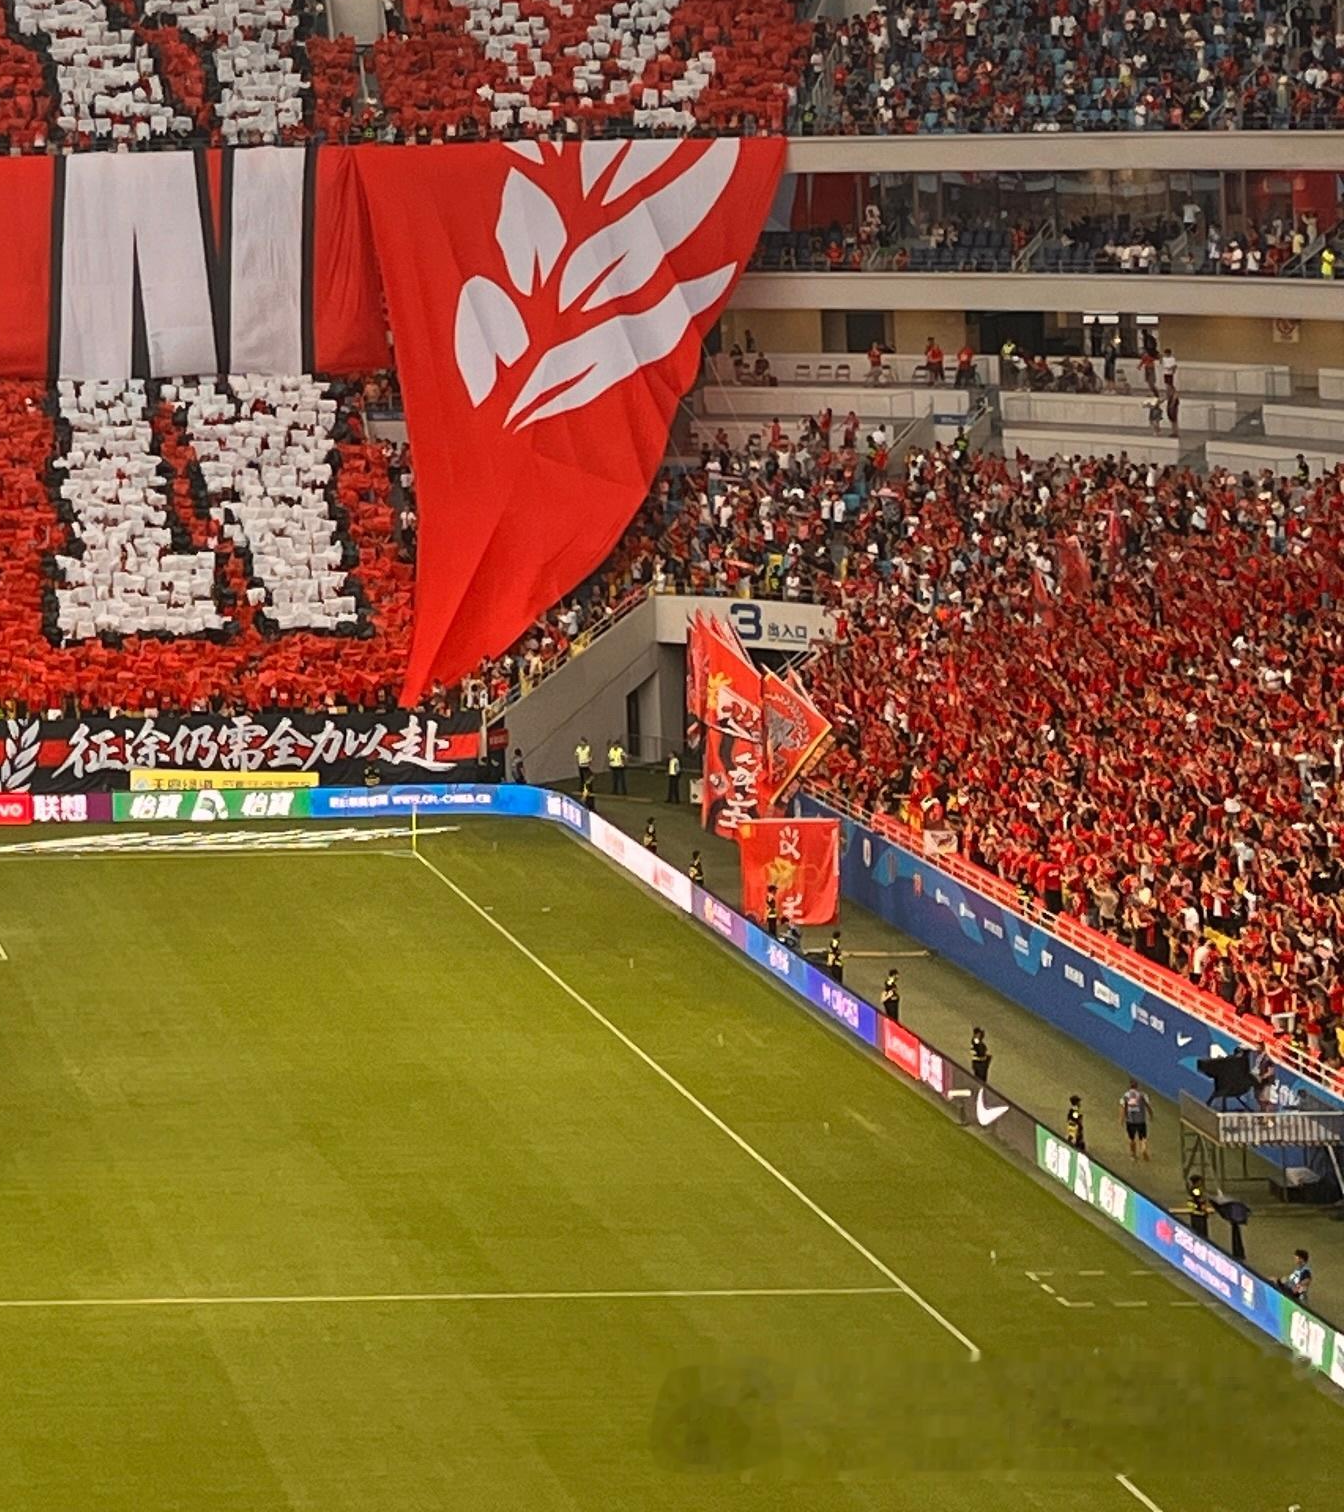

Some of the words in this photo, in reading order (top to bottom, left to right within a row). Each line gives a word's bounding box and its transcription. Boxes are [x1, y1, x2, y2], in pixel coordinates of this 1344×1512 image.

[730, 603, 763, 641] 3
[768, 622, 807, 639] 出入口
[51, 715, 458, 779] 征途仍需全力以赴
[32, 794, 88, 822] 联想
